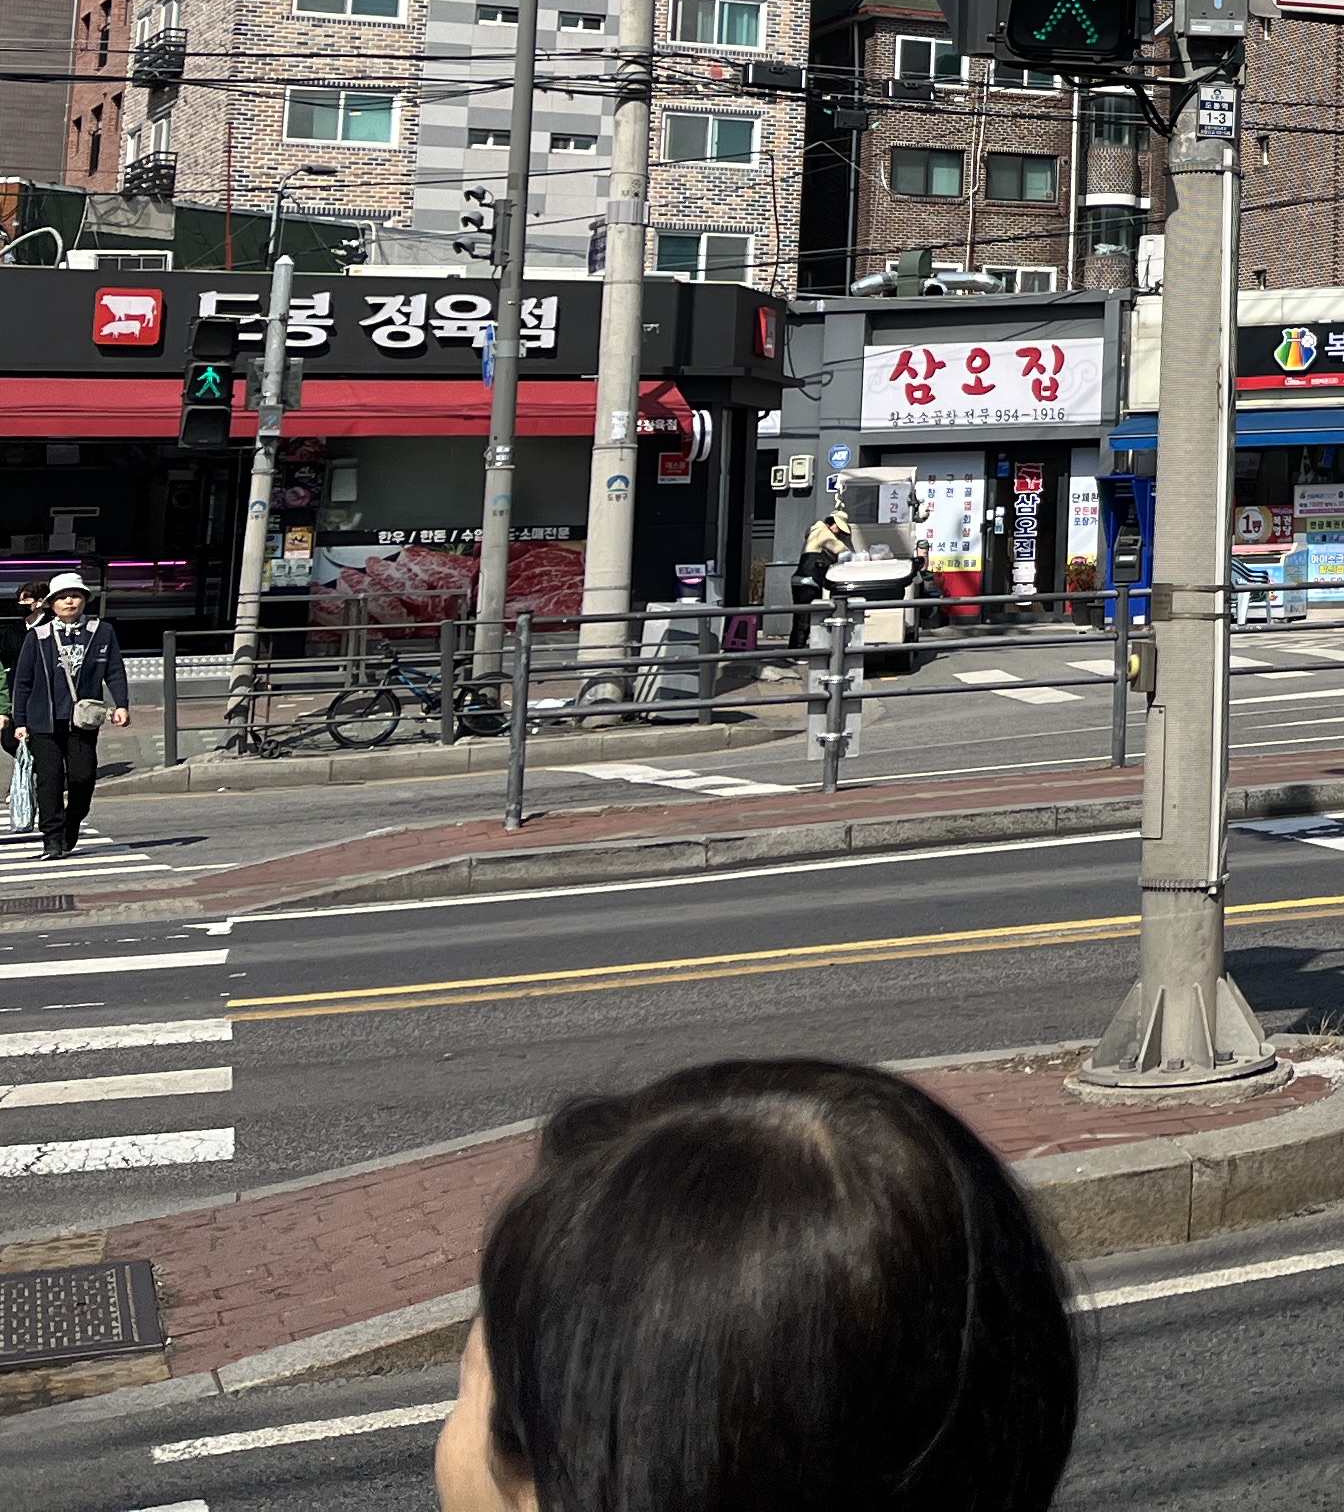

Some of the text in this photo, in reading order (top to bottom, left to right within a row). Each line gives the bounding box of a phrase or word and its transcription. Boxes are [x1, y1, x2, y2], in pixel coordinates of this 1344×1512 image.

[1207, 112, 1226, 124] 1-3
[889, 344, 1065, 405] 삼오집
[964, 408, 990, 424] 전문
[995, 408, 1065, 423] 954-1916
[1014, 493, 1041, 561] 삼오집
[378, 530, 406, 544] 한우
[420, 529, 447, 543] 한돈
